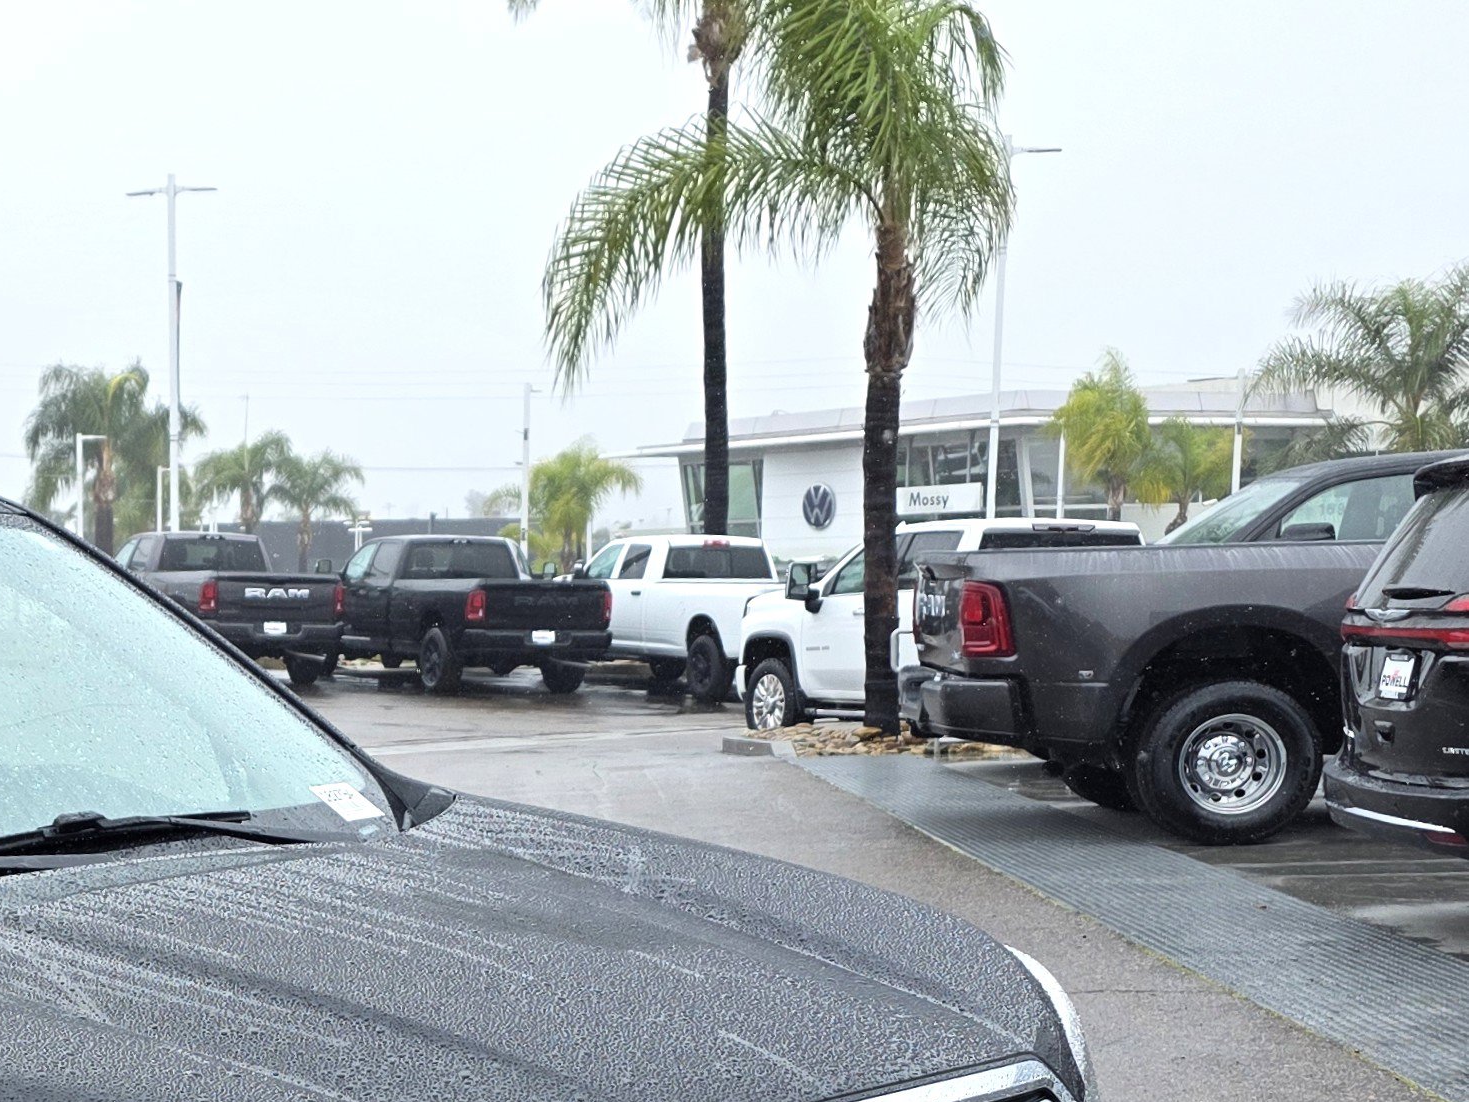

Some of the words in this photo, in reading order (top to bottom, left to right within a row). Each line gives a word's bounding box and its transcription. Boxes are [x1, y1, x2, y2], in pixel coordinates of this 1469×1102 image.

[908, 491, 949, 509] Mossy
[244, 587, 310, 599] RAM
[514, 596, 580, 607] RAM
